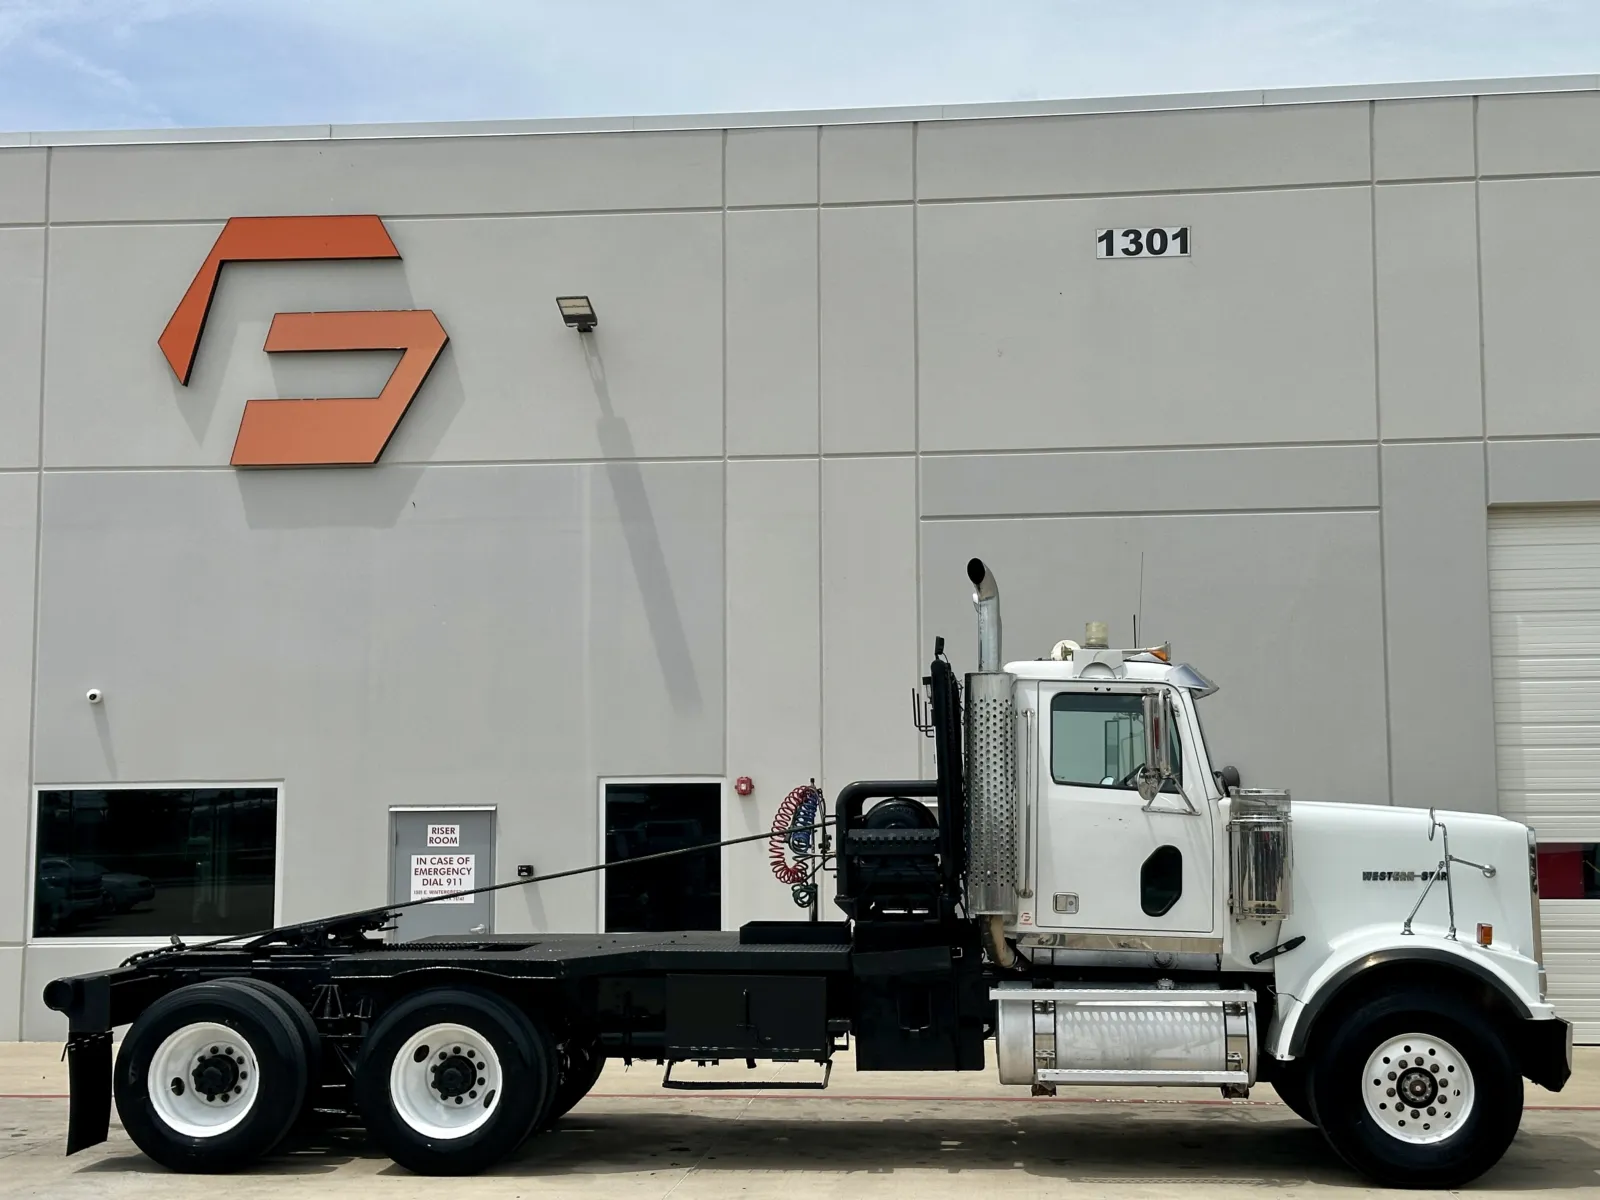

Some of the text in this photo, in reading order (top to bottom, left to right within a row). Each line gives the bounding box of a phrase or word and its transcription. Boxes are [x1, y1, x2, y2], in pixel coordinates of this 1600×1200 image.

[1098, 228, 1188, 256] 1301
[416, 857, 470, 865] IN CASE OF
[414, 868, 472, 876] EMERGENCY
[1362, 871, 1415, 881] WESTERN
[422, 878, 462, 886] DIAL 911
